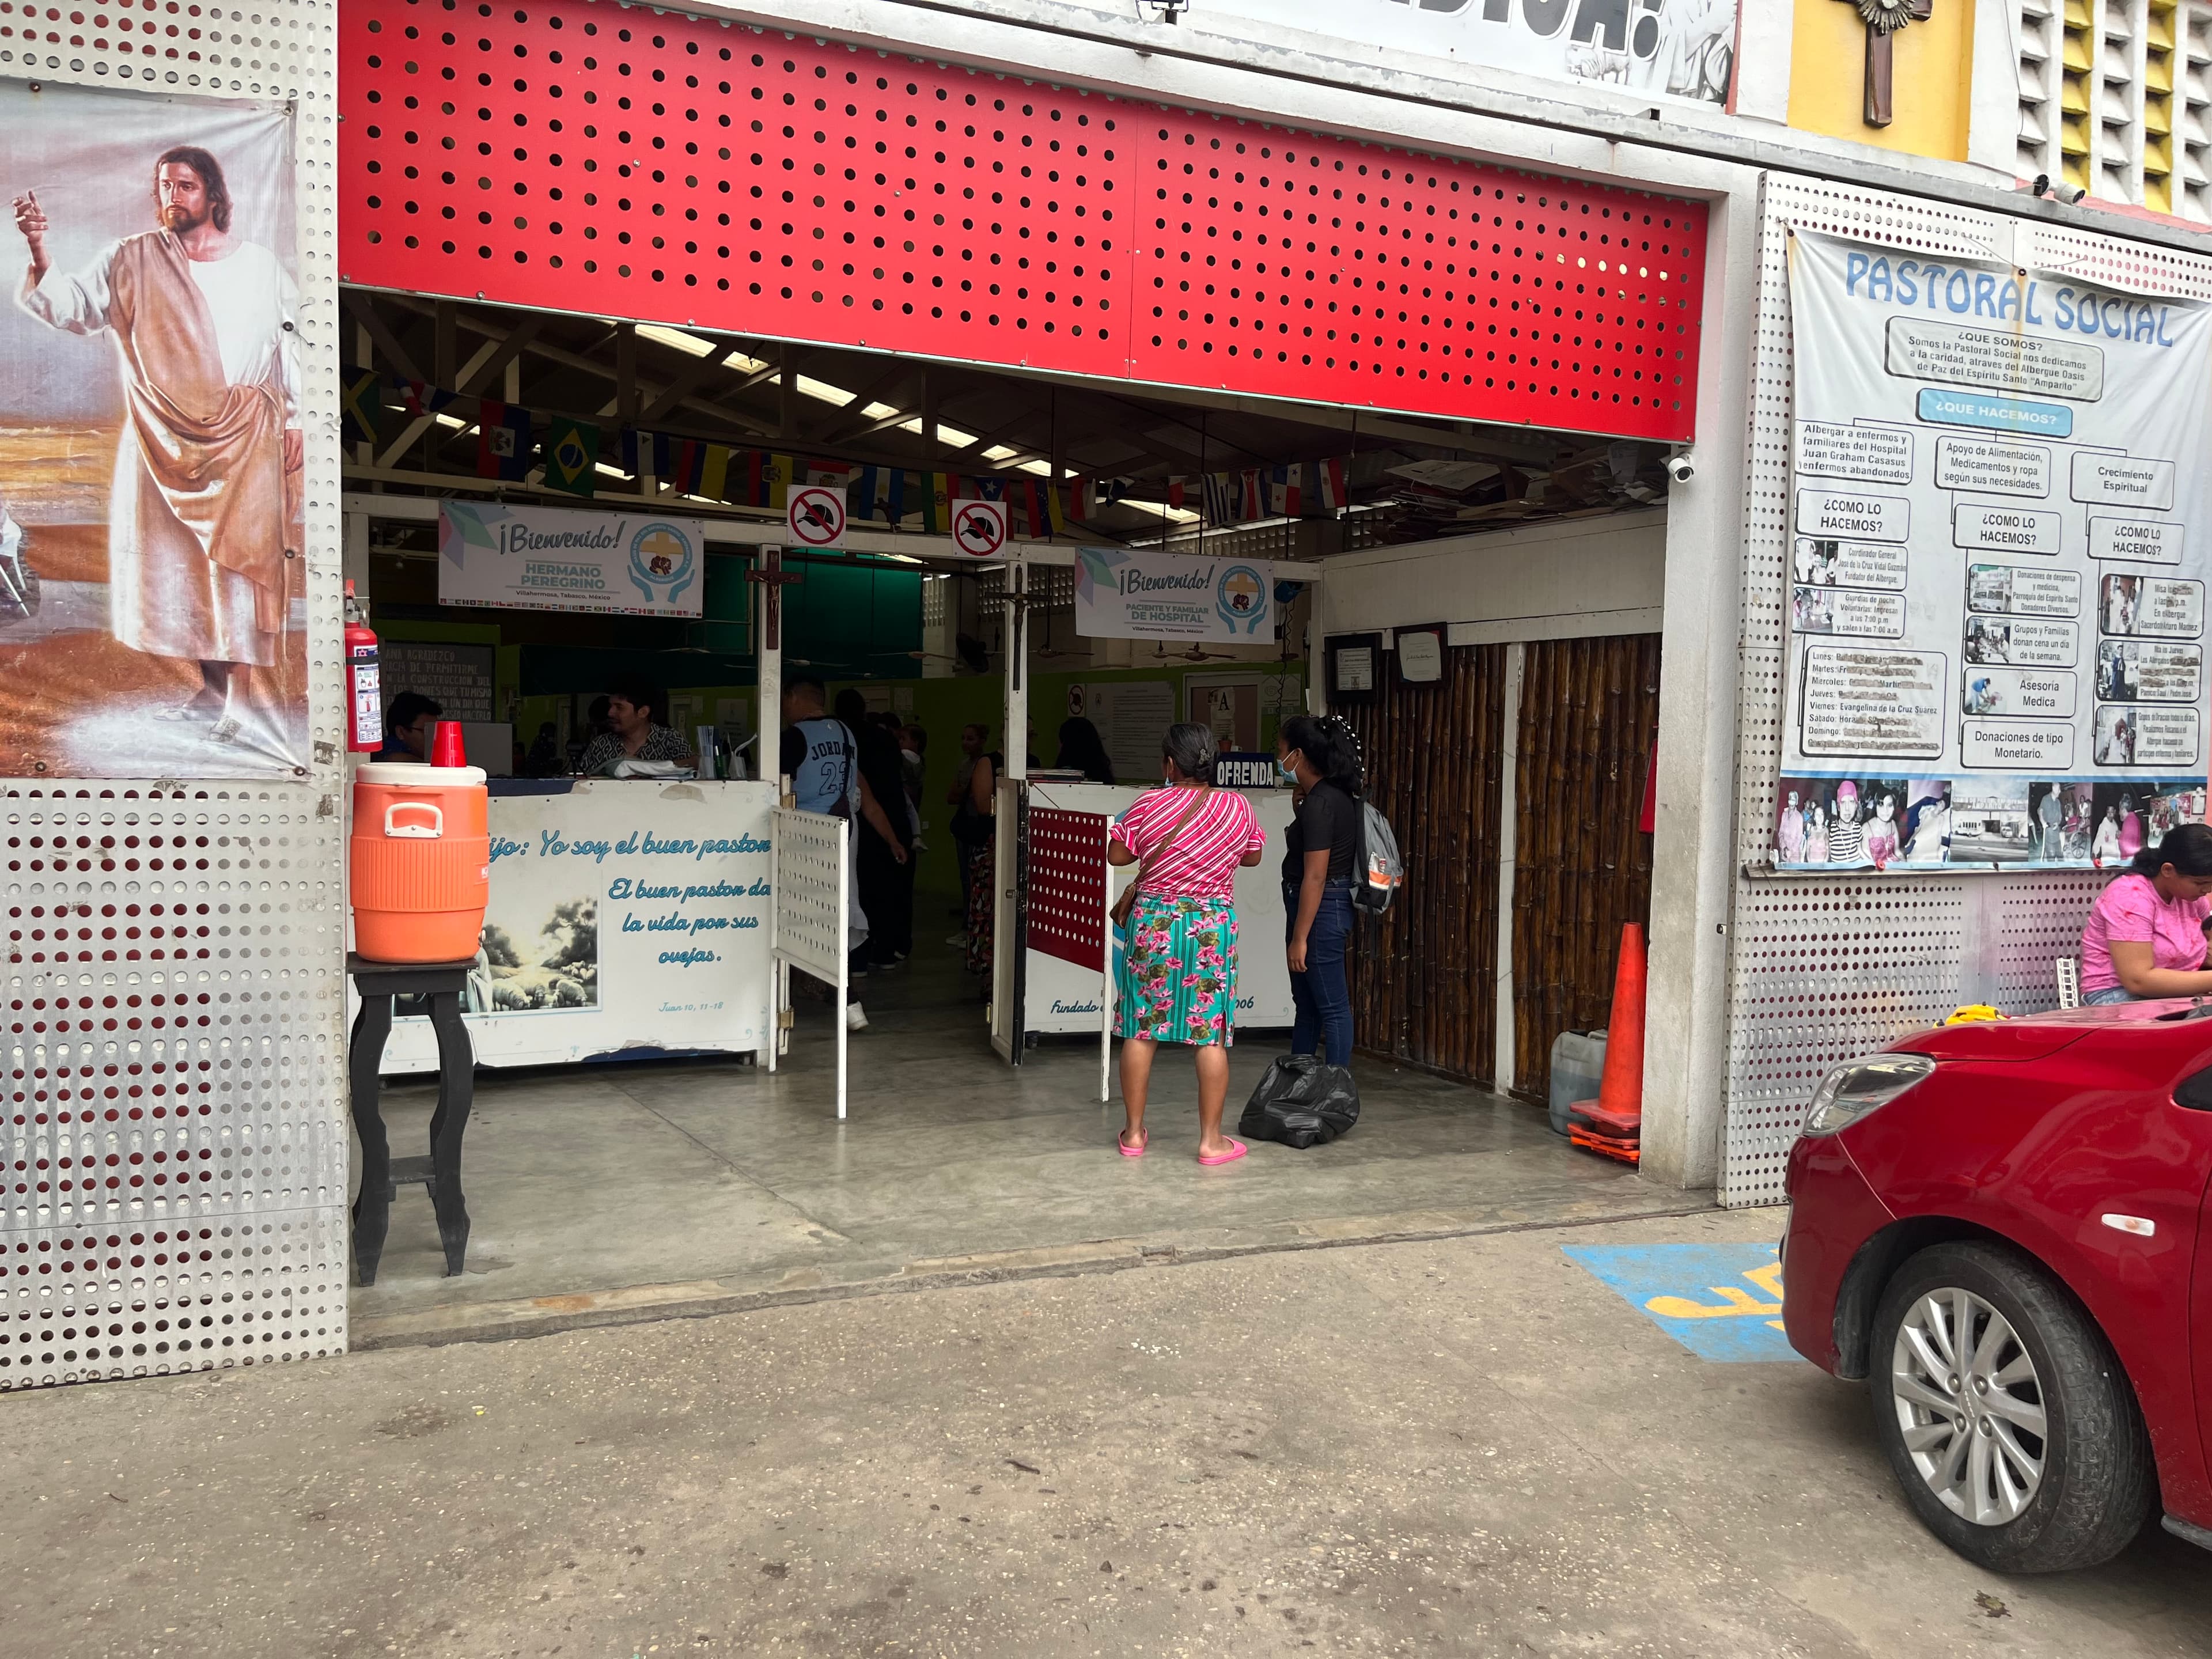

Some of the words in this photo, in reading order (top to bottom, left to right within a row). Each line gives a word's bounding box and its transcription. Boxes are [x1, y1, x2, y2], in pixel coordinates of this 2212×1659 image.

[1846, 252, 2043, 325] PASTORAL
[2055, 287, 2173, 347] SOCIAL
[1958, 331, 1990, 343] ¿QUE
[1994, 336, 2043, 351] SOMOS?
[1908, 336, 1940, 349] Somos
[1943, 340, 1951, 350] la
[1955, 343, 1991, 355] Pastoral
[1994, 349, 2021, 360] Social
[2023, 354, 2039, 363] nos
[2041, 356, 2086, 370] dedicamos
[1918, 349, 1927, 358] la
[1930, 353, 1967, 365] caridad,
[1969, 358, 2002, 369] atraves
[2005, 359, 2018, 372] del
[2021, 364, 2060, 377] Albergue
[2062, 370, 2085, 381] Oasis
[1917, 362, 1928, 371] de
[1931, 363, 1947, 373] Paz
[1950, 365, 1964, 376] del
[2003, 373, 2027, 385] Santo
[1936, 402, 1975, 415] ¿QUE
[1979, 406, 2057, 425] HACEMOS?
[1805, 425, 1845, 438] Albergar
[1857, 431, 1899, 442] enfermos
[1902, 436, 1906, 445] y
[1803, 436, 1850, 449] familiares
[1853, 442, 1867, 451] del
[1870, 444, 1906, 455] Hospital
[1946, 442, 1974, 456] Apoyo
[1976, 445, 1986, 456] de
[1988, 447, 2043, 464] Alimentación,
[1803, 449, 1827, 459] Juan
[1830, 451, 1865, 463] Graham
[1868, 455, 1906, 467] Casasus
[1850, 465, 1910, 479] abandonados
[1950, 457, 2010, 473] Medicamentos
[2013, 466, 2018, 475] y
[2020, 466, 2038, 477] ropa
[2098, 467, 2154, 480] Crecimiento
[1944, 472, 1970, 484] según
[1972, 475, 1987, 484] sus
[1990, 477, 2042, 490] necesidades.
[2104, 480, 2148, 493] Espiritual
[1824, 499, 1864, 513] ¿COMO
[1868, 503, 1881, 514] LO
[1820, 516, 1883, 532] HACEMOS?
[1983, 513, 2019, 527] ¿COMO
[2022, 517, 2035, 529] LO
[500, 521, 627, 555] ¡Bienvenido!
[1980, 530, 2036, 546] HACEMOS?
[2115, 526, 2149, 539] ¿COMO
[2151, 529, 2161, 540] LO
[1878, 550, 1897, 559] General
[2113, 541, 2161, 556] HACEMOS?
[525, 563, 601, 578] HERMANO
[1850, 560, 1856, 569] de
[1862, 561, 1873, 570] Cruz
[1874, 562, 1887, 570] Vidal
[521, 575, 605, 589] PEREGRINO
[1120, 564, 1215, 596] ¡Bienvenido!
[516, 590, 559, 599] Villahermosa,
[1878, 596, 1895, 604] noche
[1131, 611, 1147, 620] DE
[1150, 612, 1204, 623] HOSPITAL
[1173, 606, 1209, 614] FAMILIAR
[1874, 607, 1898, 615] Ingresan
[2014, 624, 2037, 635] Grupos
[2039, 627, 2043, 637] y
[2044, 626, 2069, 636] Familias
[2013, 637, 2033, 647] donan
[2034, 639, 2049, 647] cena
[2051, 640, 2059, 648] un
[407, 649, 456, 662] AGRADEZCO
[2020, 650, 2028, 659] de
[2029, 651, 2035, 660] la
[2036, 653, 2062, 661] semana.
[411, 662, 421, 672] DE
[426, 664, 479, 674] PERMITIRME
[1810, 689, 1836, 698] Jueves:
[1810, 702, 1838, 710] Viernes:
[1840, 703, 1877, 713] Evangelina
[1878, 704, 1887, 713] de
[1889, 704, 1895, 713] la
[1897, 705, 1913, 713] Cruz
[2022, 696, 2055, 707] Medica
[1808, 726, 1841, 737] Domingo:
[1975, 730, 2029, 743] Donaciones
[2032, 732, 2044, 743] de
[2047, 733, 2063, 745] tipo
[812, 741, 855, 760] JORD
[1995, 747, 2043, 759] Monetario.
[1217, 760, 1274, 786] OFRENDA
[488, 833, 529, 863] ijo:
[540, 830, 570, 857] Yo
[571, 840, 612, 864] soy
[615, 831, 639, 854] el
[642, 831, 698, 854] buen
[696, 832, 771, 861] pastor
[608, 878, 632, 899] El
[635, 879, 683, 899] buen
[680, 880, 747, 904] pastor
[748, 877, 771, 896] da
[622, 912, 645, 932] la
[647, 911, 691, 931] vida
[690, 917, 729, 936] por
[730, 916, 759, 929] sus
[658, 947, 722, 968] ovejas.
[658, 1002, 683, 1012] Juan
[1050, 999, 1099, 1014] Fundado
